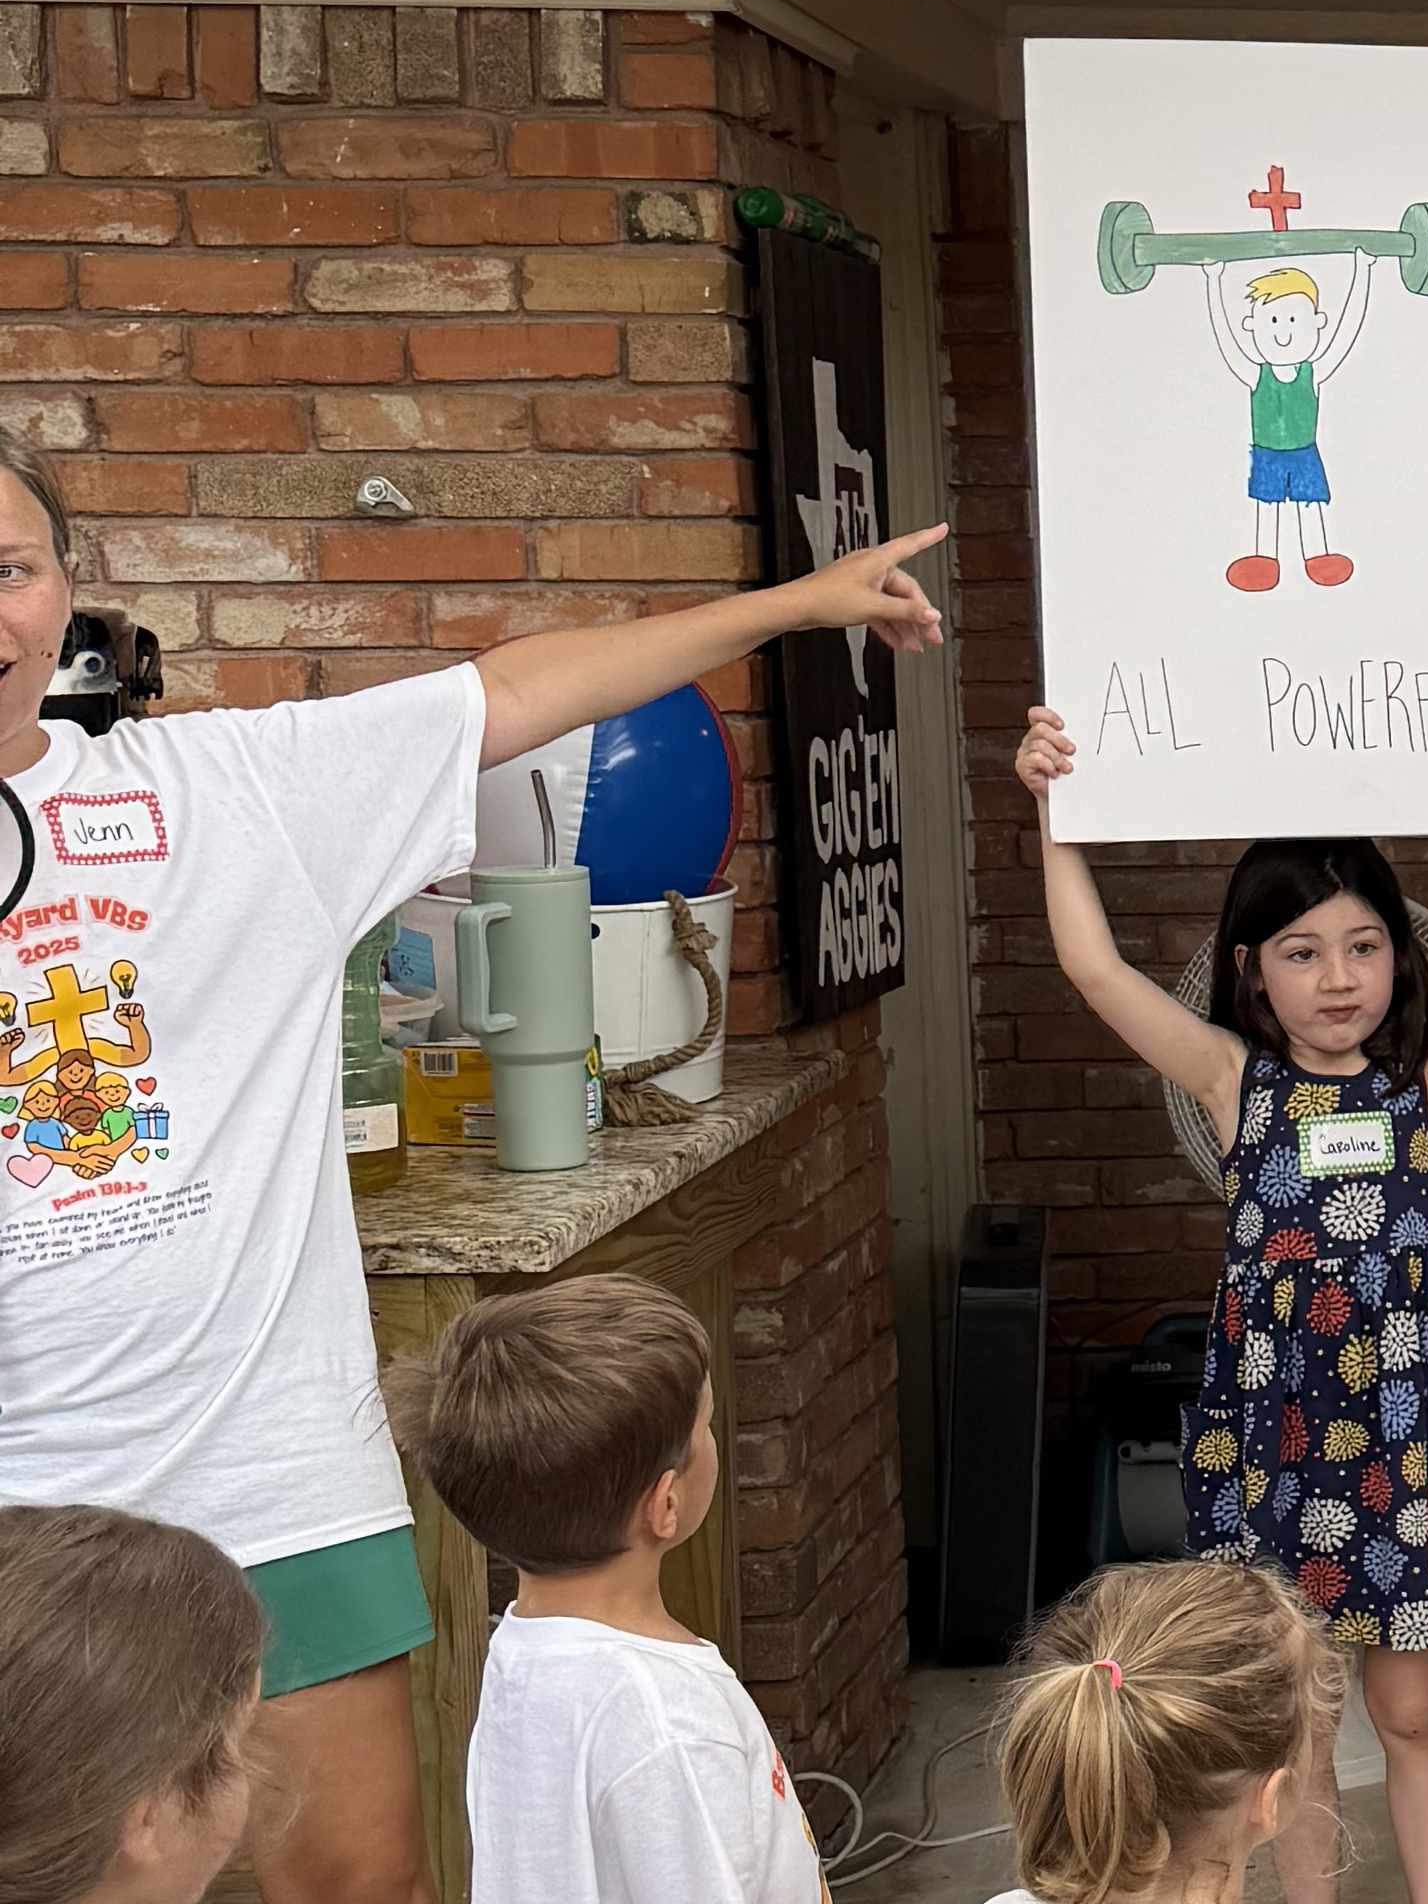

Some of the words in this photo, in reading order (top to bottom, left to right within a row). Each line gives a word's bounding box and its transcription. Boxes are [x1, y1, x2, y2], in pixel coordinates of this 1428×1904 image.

[1097, 658, 1203, 755] ALL
[74, 817, 134, 845] Jenn
[0, 897, 79, 941] yard
[90, 897, 149, 932] VBS
[818, 857, 901, 987] AGGIES
[18, 936, 81, 965] 2025
[1320, 1134, 1380, 1155] Caroline
[52, 1187, 97, 1211] Psalm
